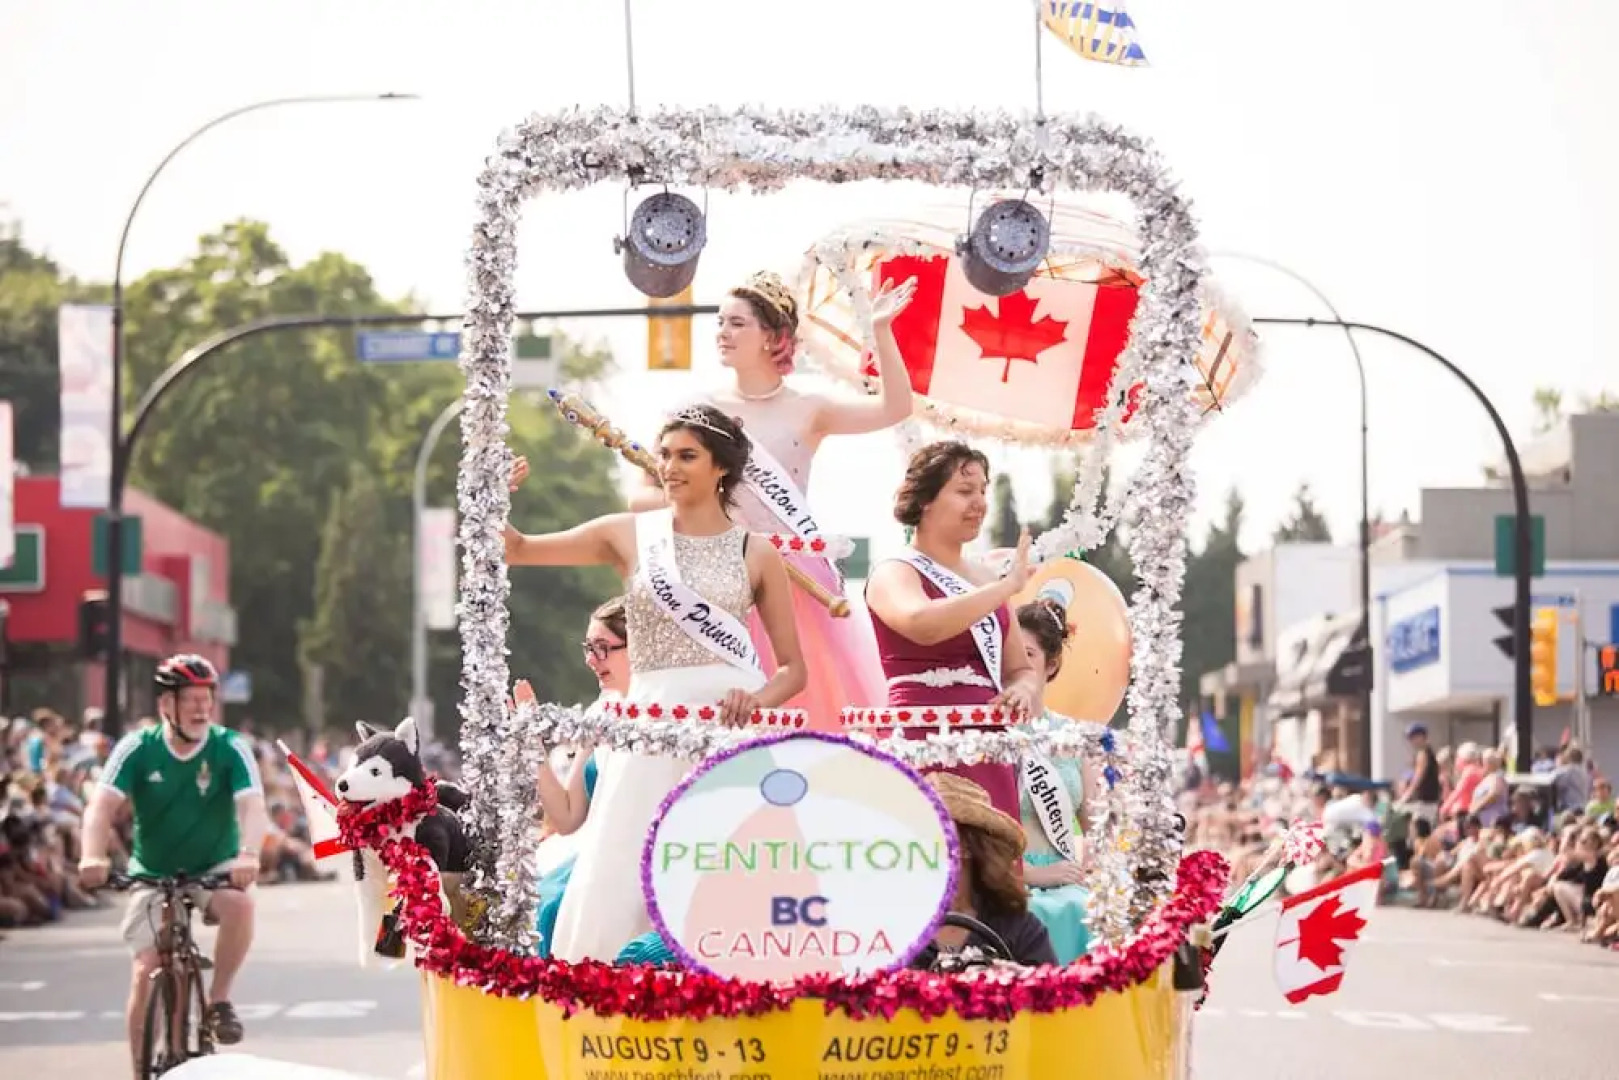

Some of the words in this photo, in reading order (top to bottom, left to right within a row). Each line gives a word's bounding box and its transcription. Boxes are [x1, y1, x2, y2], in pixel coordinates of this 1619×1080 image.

[681, 603, 748, 658] Princess
[661, 840, 941, 872] PENTICTON
[771, 896, 829, 926] BC
[697, 930, 894, 958] CANADA
[582, 1035, 684, 1062] AUGUST
[693, 1038, 708, 1062] 9
[733, 1038, 766, 1063] 13
[822, 1034, 939, 1062] AUGUST
[945, 1033, 959, 1057] 9
[984, 1029, 1010, 1056] 13
